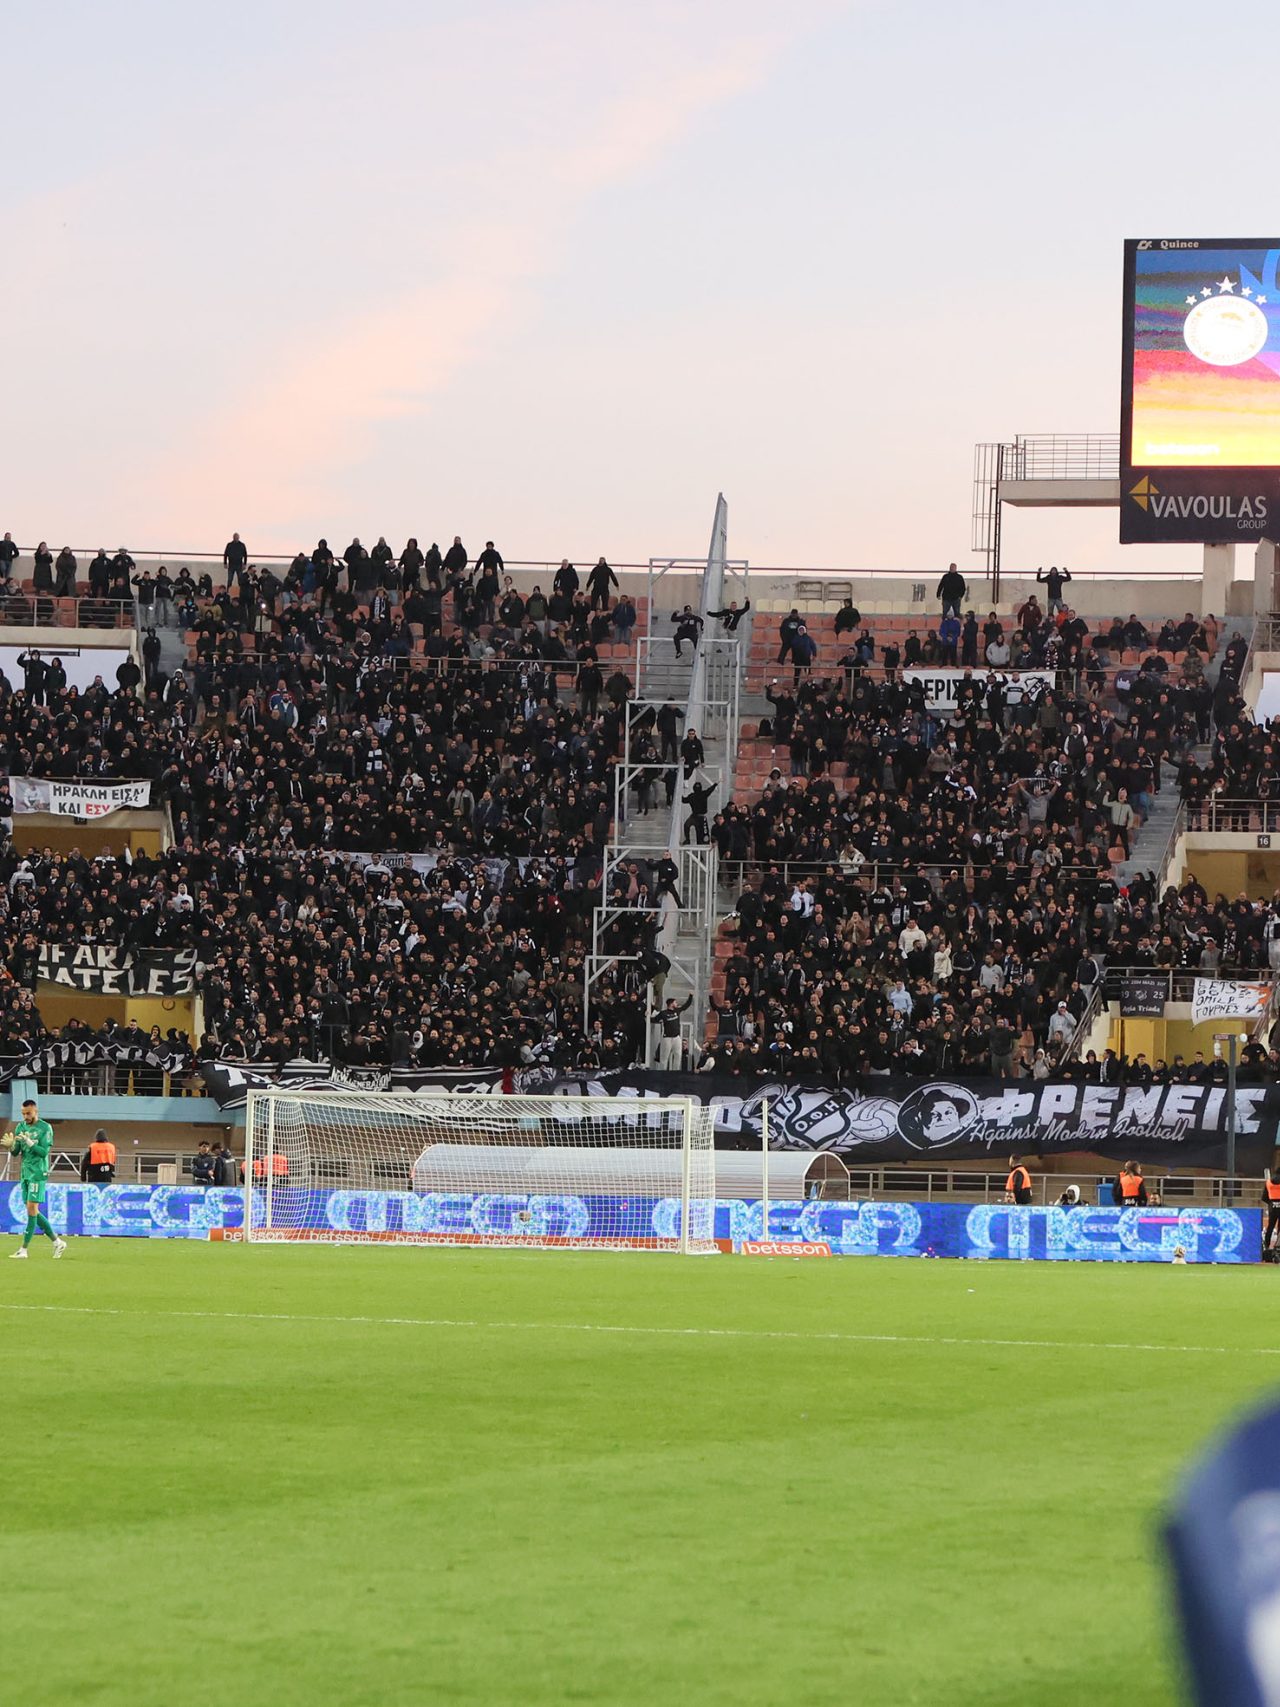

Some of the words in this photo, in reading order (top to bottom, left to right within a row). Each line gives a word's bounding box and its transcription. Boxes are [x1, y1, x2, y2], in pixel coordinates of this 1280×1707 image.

[1160, 241, 1199, 250] Quince
[1150, 495, 1267, 519] VAVOULAS
[1237, 519, 1267, 530] GROUP
[53, 784, 107, 800] ΗΡΑΚΛΗ
[1258, 836, 1270, 846] 16
[1153, 990, 1165, 999] 25
[969, 1116, 1039, 1150] Against
[1041, 1118, 1109, 1142] Modern
[1112, 1115, 1188, 1142] Football
[746, 1241, 826, 1256] betsson
